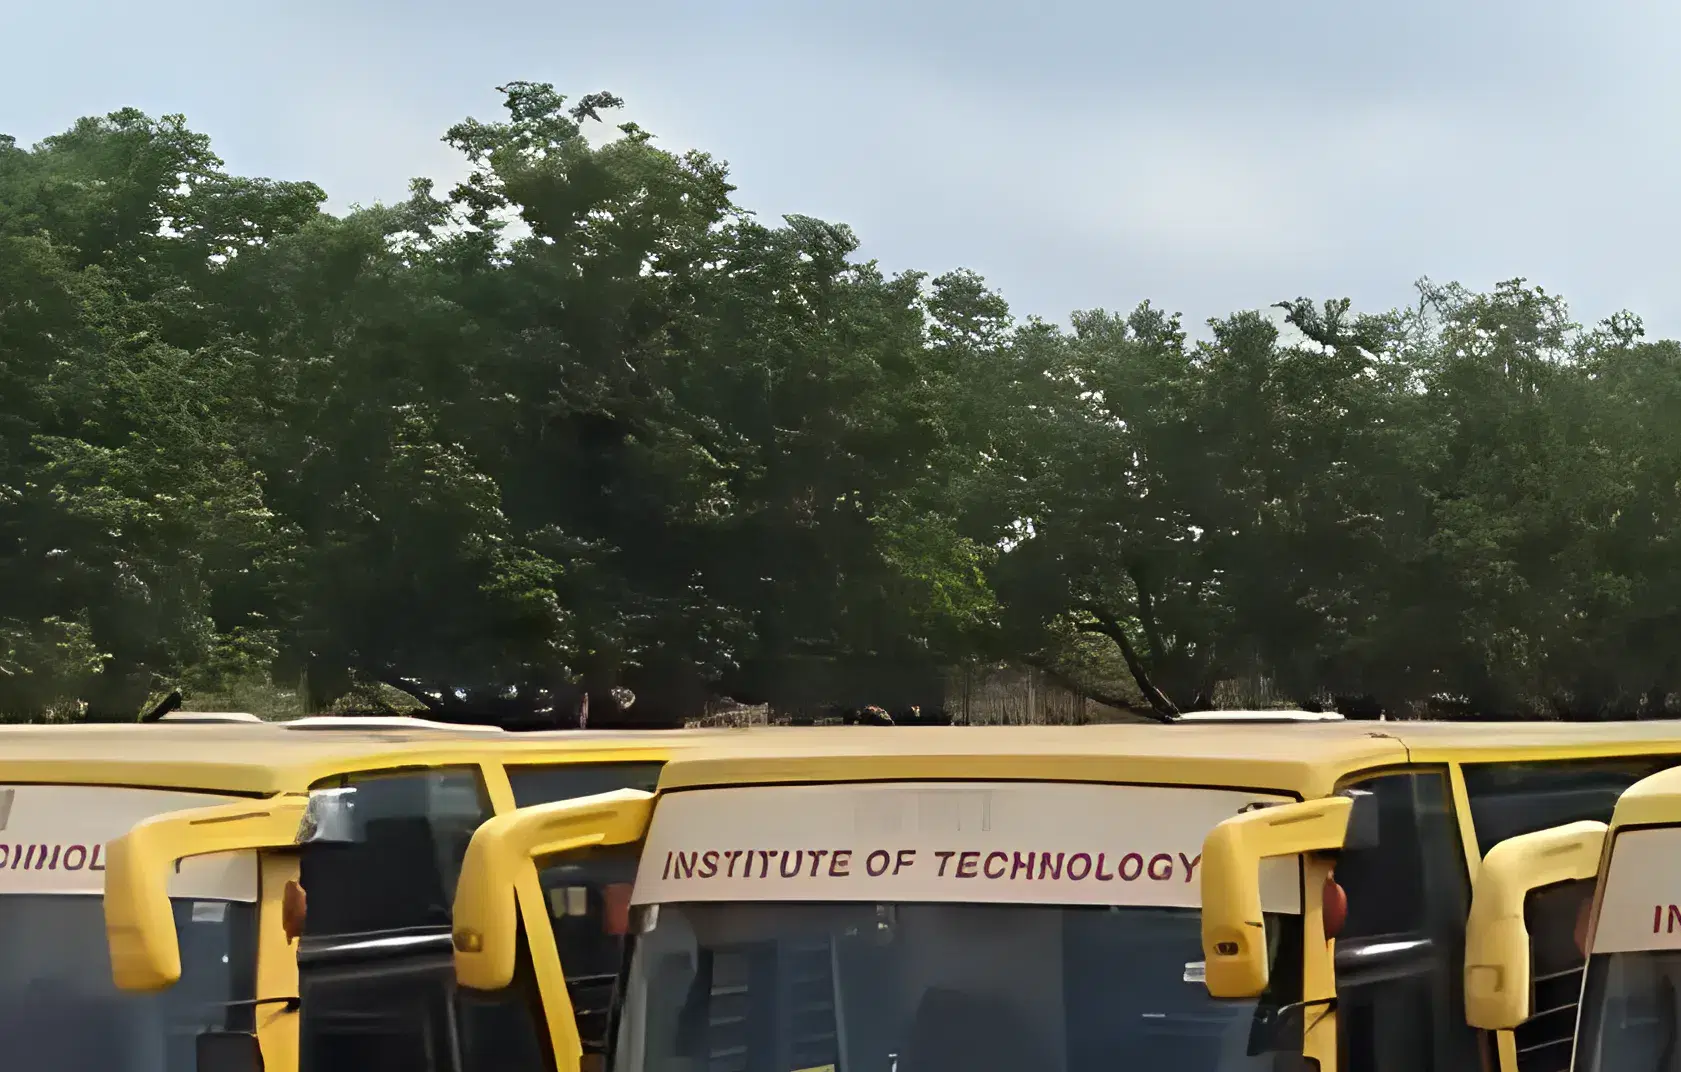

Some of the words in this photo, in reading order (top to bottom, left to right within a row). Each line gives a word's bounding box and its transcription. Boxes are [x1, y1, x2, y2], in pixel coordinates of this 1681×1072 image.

[662, 849, 853, 880] INSTITUTE
[866, 849, 916, 877] OF
[935, 850, 1201, 883] TECHNOLOGY
